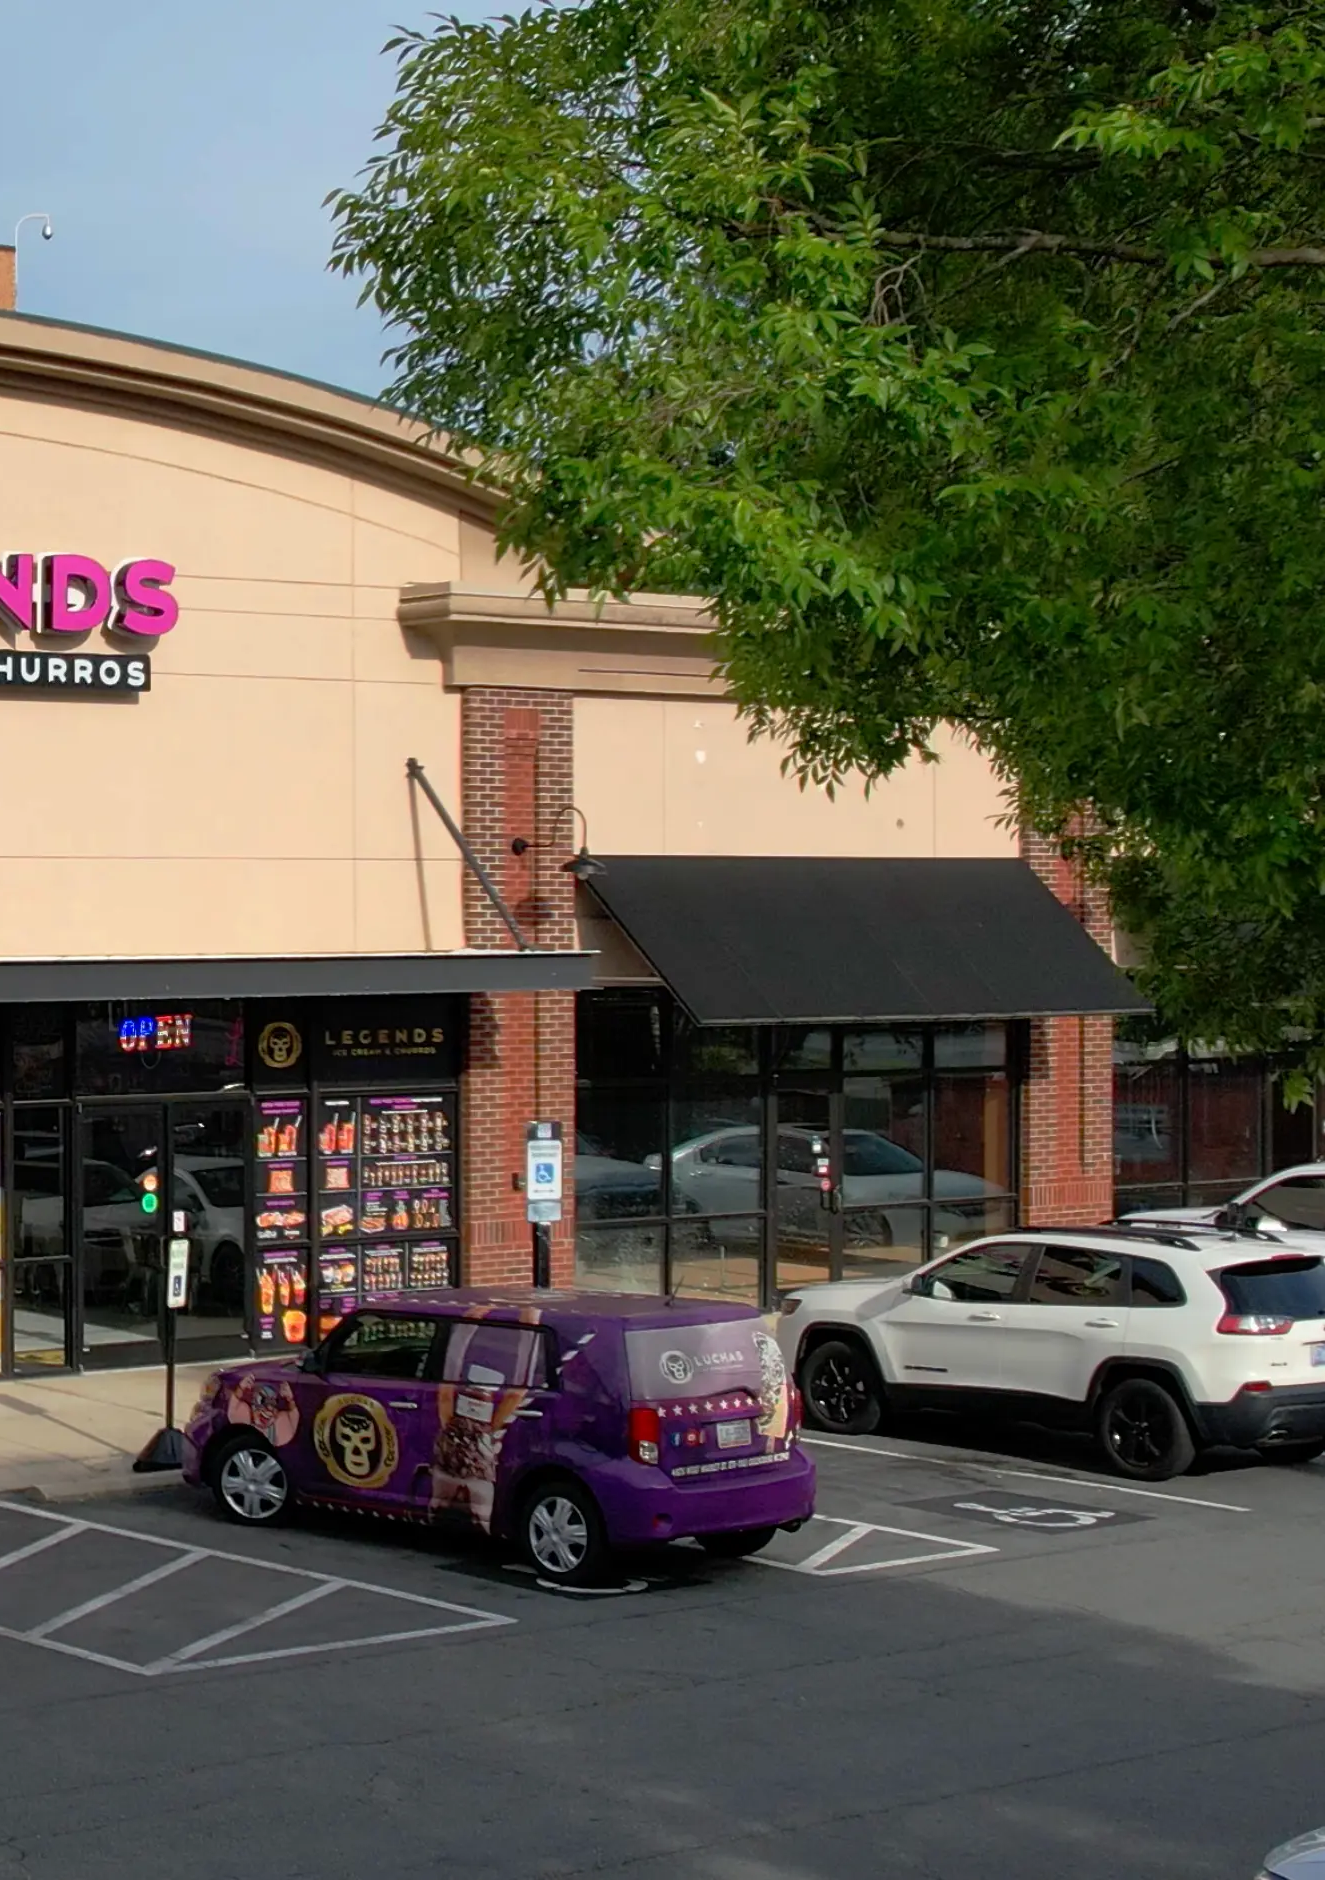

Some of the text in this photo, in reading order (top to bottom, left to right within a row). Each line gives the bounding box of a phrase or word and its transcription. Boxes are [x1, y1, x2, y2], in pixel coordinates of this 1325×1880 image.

[118, 1013, 194, 1053] OPEN
[324, 1027, 445, 1045] LEGENDS
[693, 1350, 744, 1368] LUCHAS
